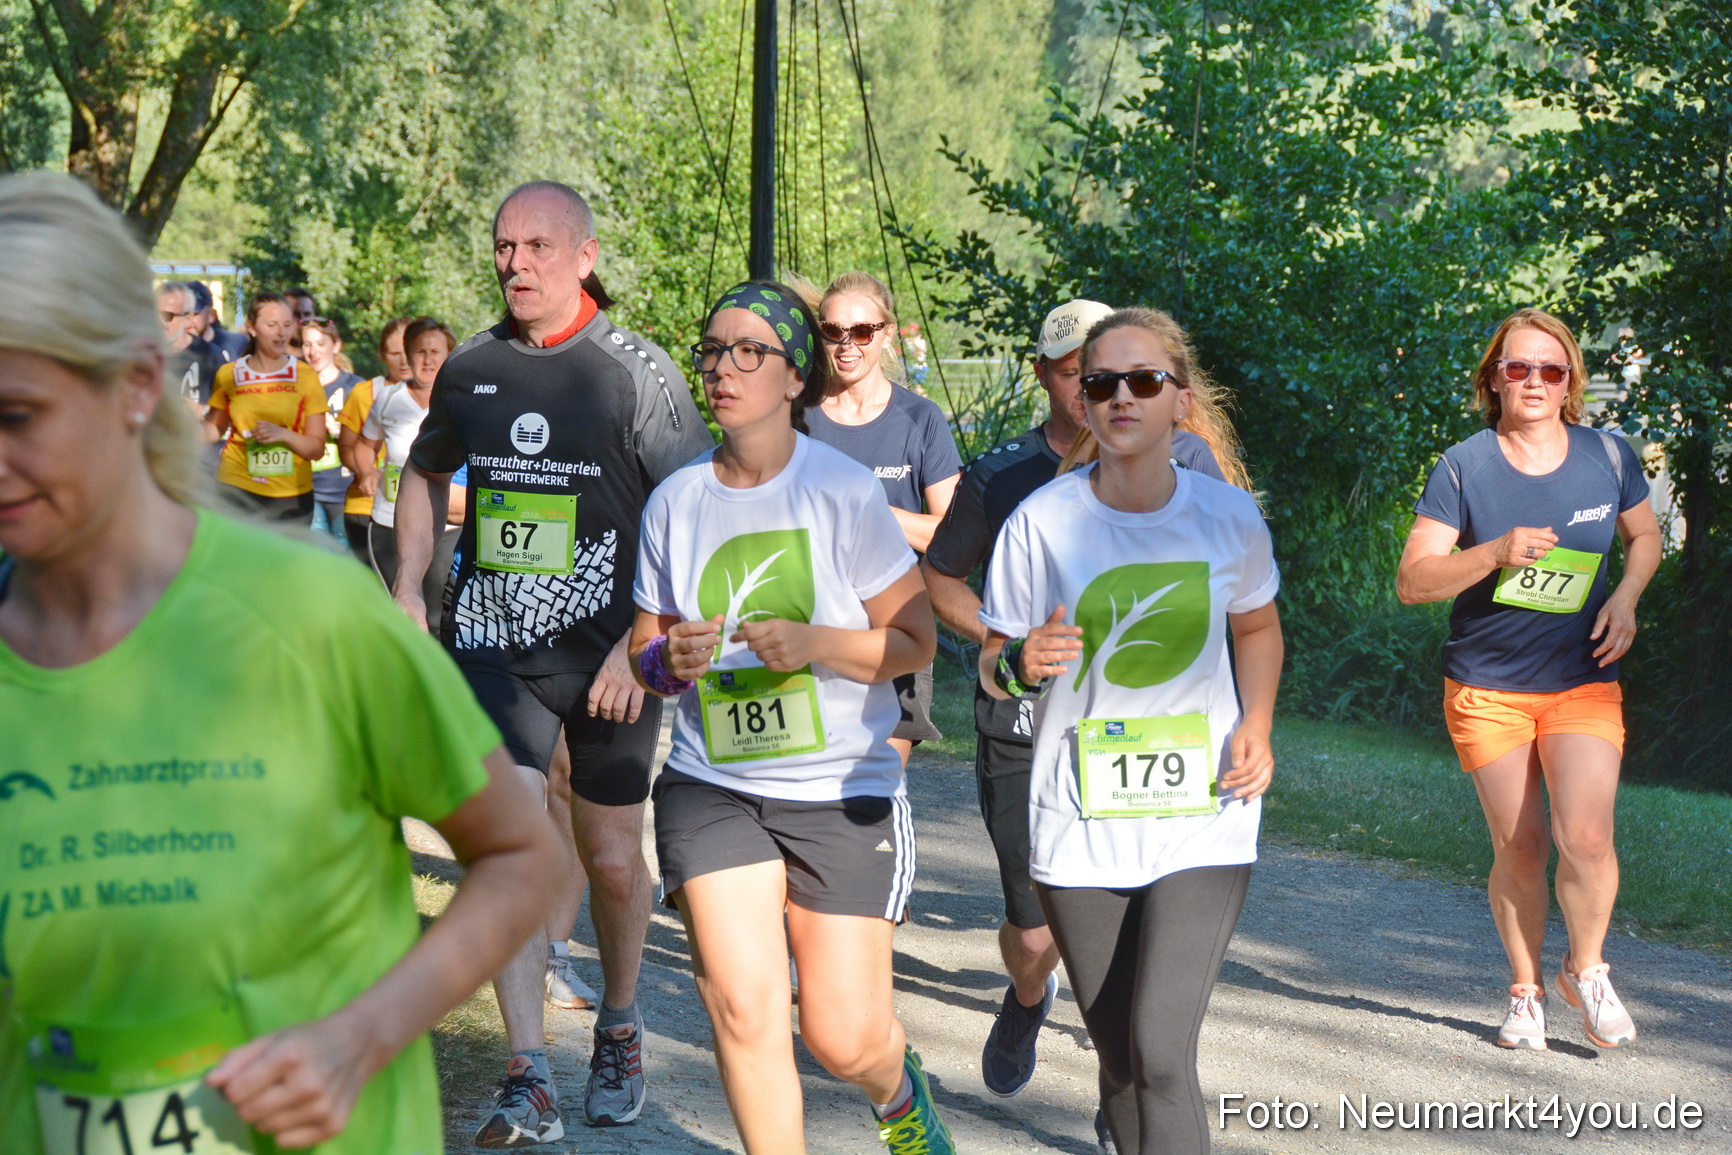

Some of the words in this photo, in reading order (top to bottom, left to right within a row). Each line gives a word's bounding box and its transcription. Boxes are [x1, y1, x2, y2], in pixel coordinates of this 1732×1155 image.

[1057, 316, 1080, 330] ROCK
[1054, 327, 1075, 341] YOU!
[266, 385, 298, 394] BÖGL
[473, 384, 497, 394] JAKO
[252, 451, 289, 466] 1307
[490, 470, 570, 487] SCHOTTERWERKE
[500, 520, 539, 551] 67
[496, 549, 520, 559] Hagen
[522, 552, 543, 561] Siggi
[1519, 567, 1575, 595] 877
[1516, 588, 1538, 598] Strobl
[1538, 592, 1570, 602] Christian
[727, 697, 786, 735] 181
[732, 737, 753, 747] Leidl
[754, 732, 791, 744] Theresa
[1096, 733, 1143, 745] firmenlauf
[743, 745, 771, 753] Bionorica
[67, 754, 267, 792] Zahnarztpraxis
[1112, 752, 1186, 789] 179
[1112, 791, 1150, 801] Bogner
[1152, 790, 1189, 799] Bettina
[20, 841, 53, 869] Dr.
[61, 836, 85, 862] R.
[94, 829, 236, 859] Silberhorn
[21, 890, 55, 918] ZA
[96, 878, 200, 909] Michalk
[63, 1091, 200, 1155] 714
